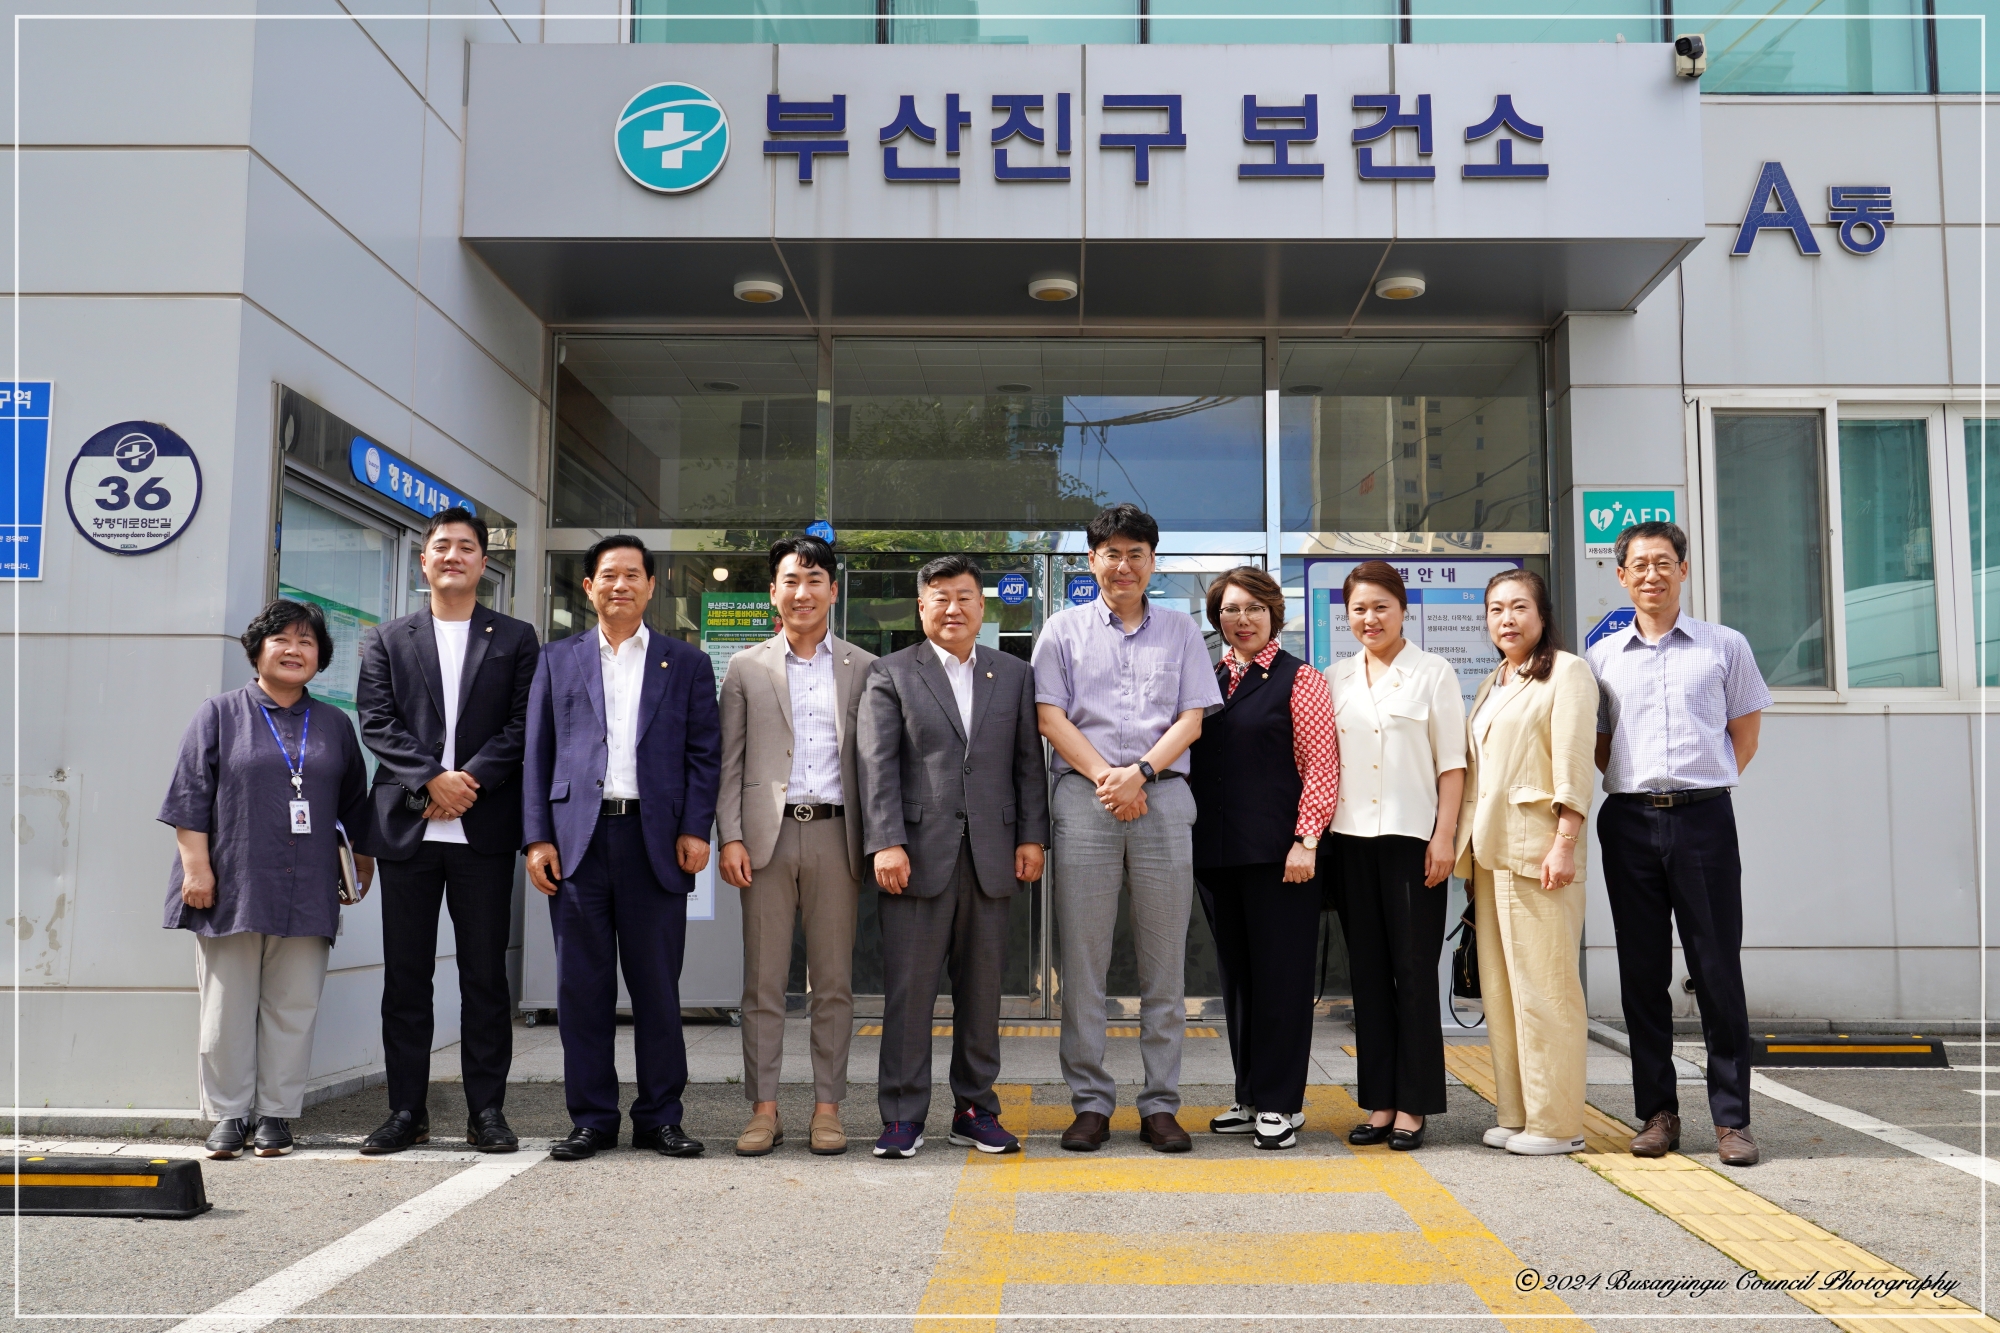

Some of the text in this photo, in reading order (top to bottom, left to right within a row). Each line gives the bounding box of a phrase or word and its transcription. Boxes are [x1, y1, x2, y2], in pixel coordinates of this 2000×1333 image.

[763, 92, 1549, 185] 부산진구 보건소
[1729, 161, 1895, 257] A동
[95, 475, 171, 511] 36
[1621, 508, 1671, 526] AED
[92, 517, 171, 529] 황령대로8번길
[92, 531, 171, 540] Hwangnyeong-daero 8beon-gil
[1003, 584, 1024, 595] ADT
[1073, 586, 1094, 597] ADT
[707, 602, 770, 610] 부산진구 26세 여성
[707, 610, 769, 618] 사람유두종바이러스
[707, 618, 767, 626] 예방접종 지원 안내
[1317, 619, 1327, 627] 3F
[1317, 655, 1327, 663] 2F
